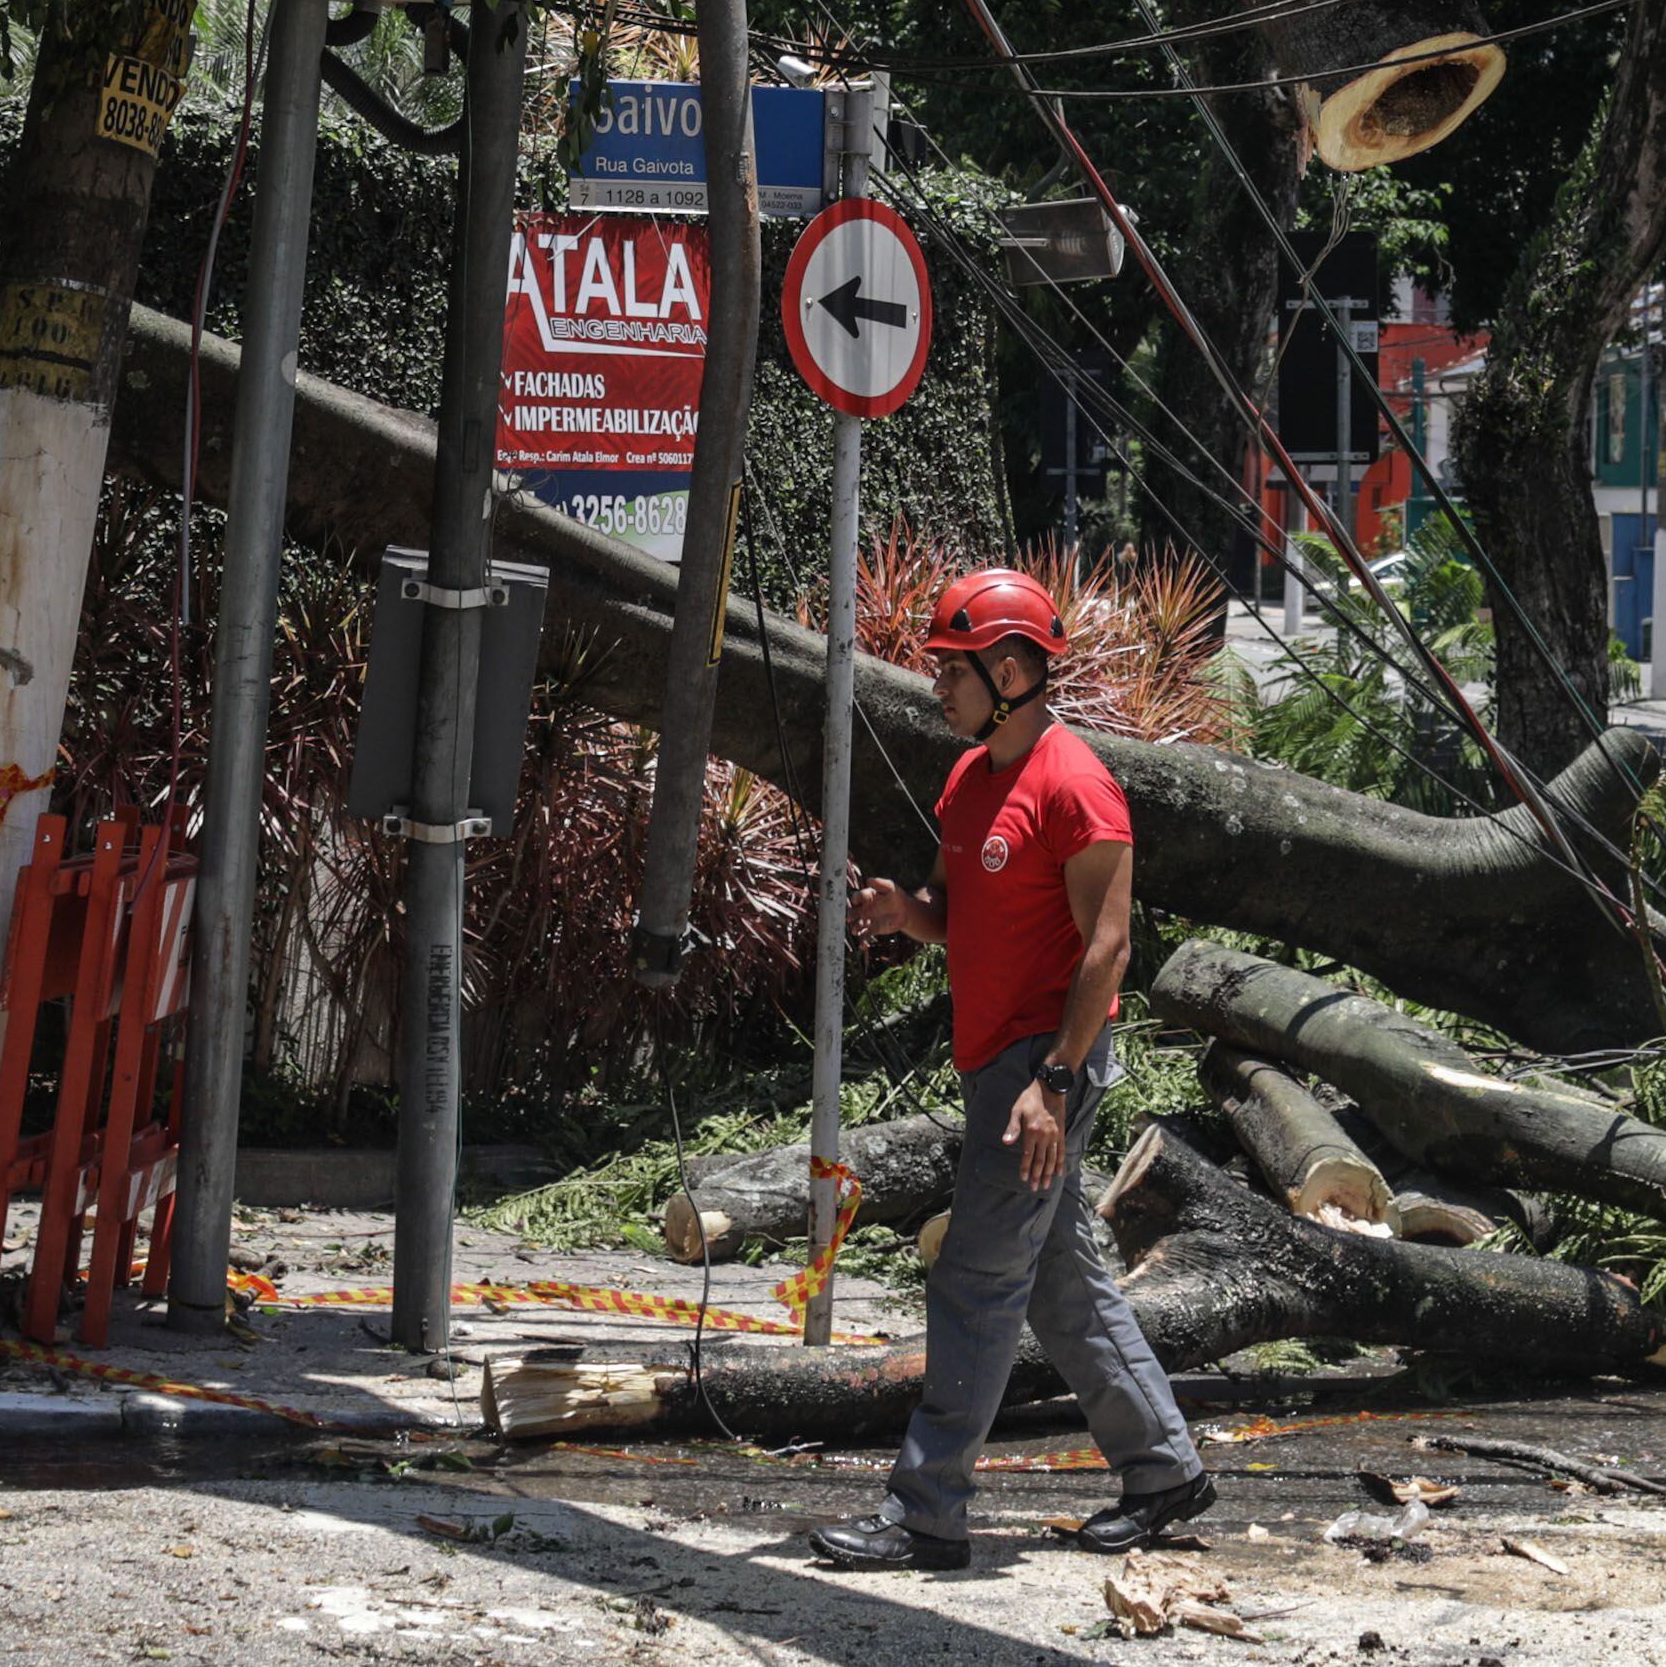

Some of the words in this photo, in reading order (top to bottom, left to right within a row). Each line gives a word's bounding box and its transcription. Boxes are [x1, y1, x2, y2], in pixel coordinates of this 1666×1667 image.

[595, 156, 628, 173] Rua
[632, 158, 694, 175] Gaivota
[580, 193, 589, 206] 7
[606, 188, 645, 205] 1128
[649, 193, 659, 205] a
[666, 190, 704, 206] 1092
[773, 192, 803, 201] Moema
[505, 232, 703, 320] ATALA
[549, 317, 708, 345] ENGENHARIA
[514, 371, 606, 400] FACHADAS
[546, 450, 571, 462] Carim
[572, 451, 594, 463] Atala
[594, 451, 619, 463] Elmor
[626, 451, 646, 464] Crea
[658, 452, 694, 465] 5060117
[571, 494, 687, 535] 3256-8628
